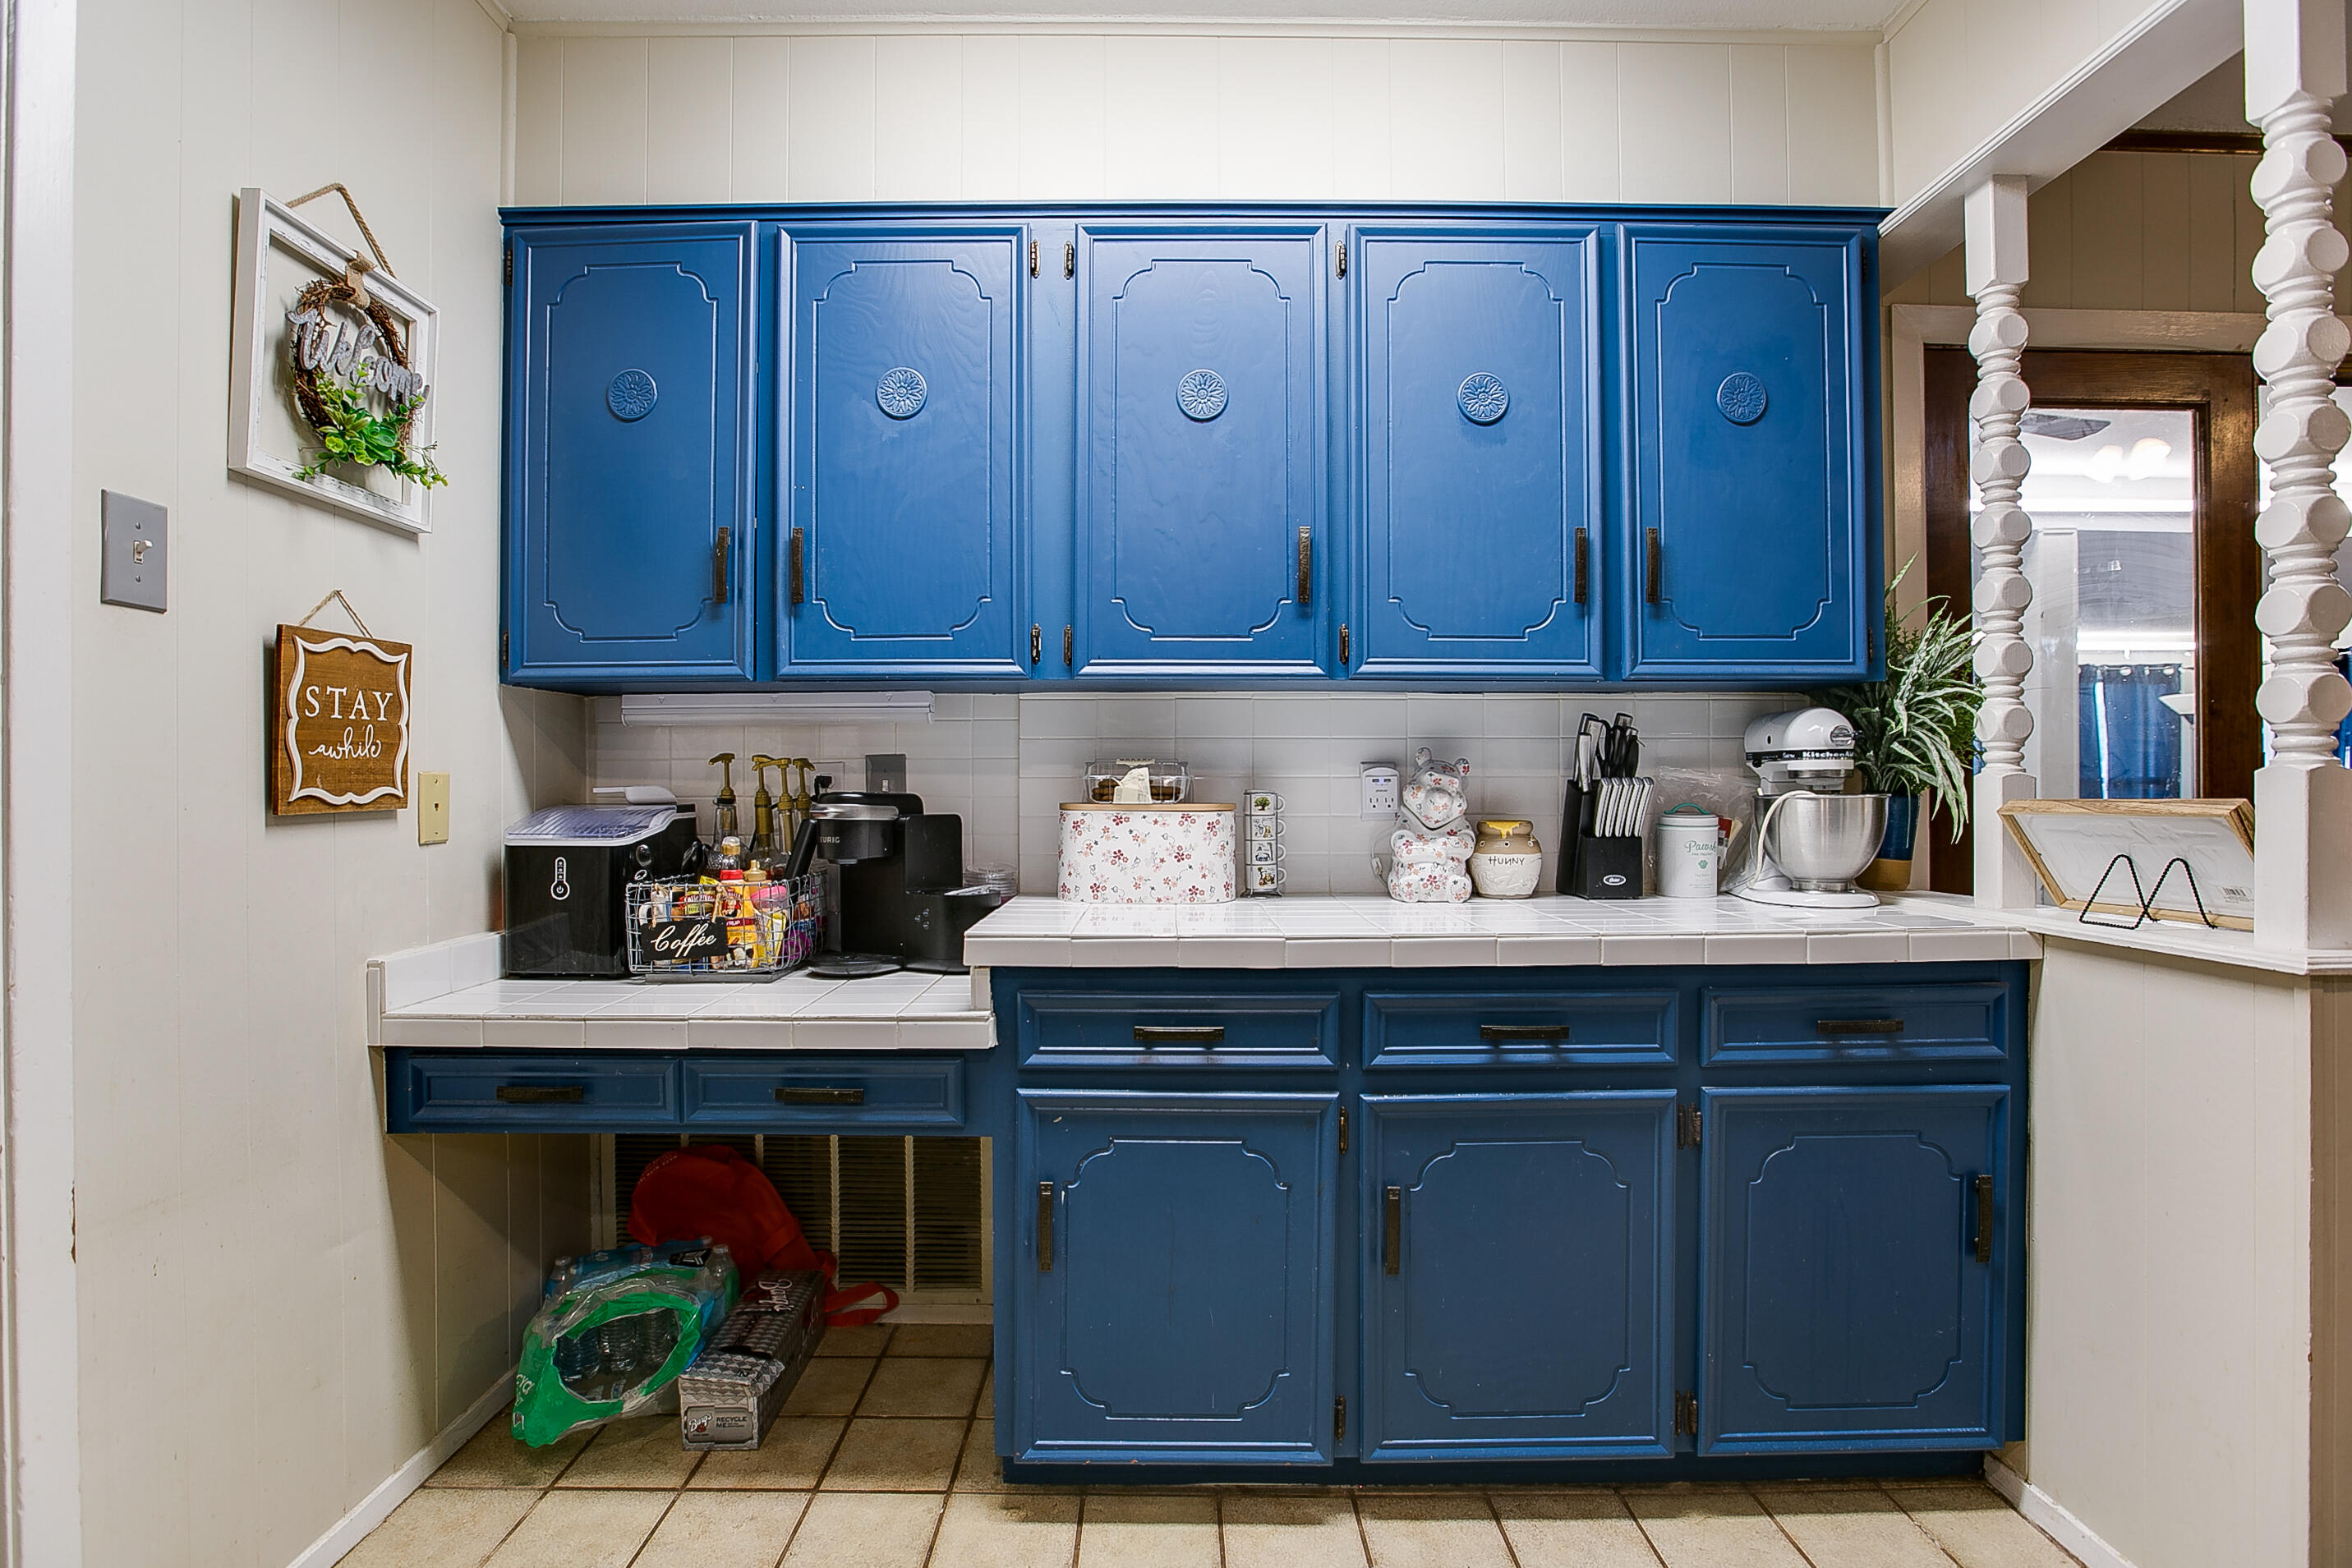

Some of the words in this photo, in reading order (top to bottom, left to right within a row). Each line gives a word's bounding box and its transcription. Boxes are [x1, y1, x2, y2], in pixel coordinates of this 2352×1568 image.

[304, 685, 394, 721] STAY
[308, 724, 382, 760] awhile
[650, 923, 717, 958] Coffee
